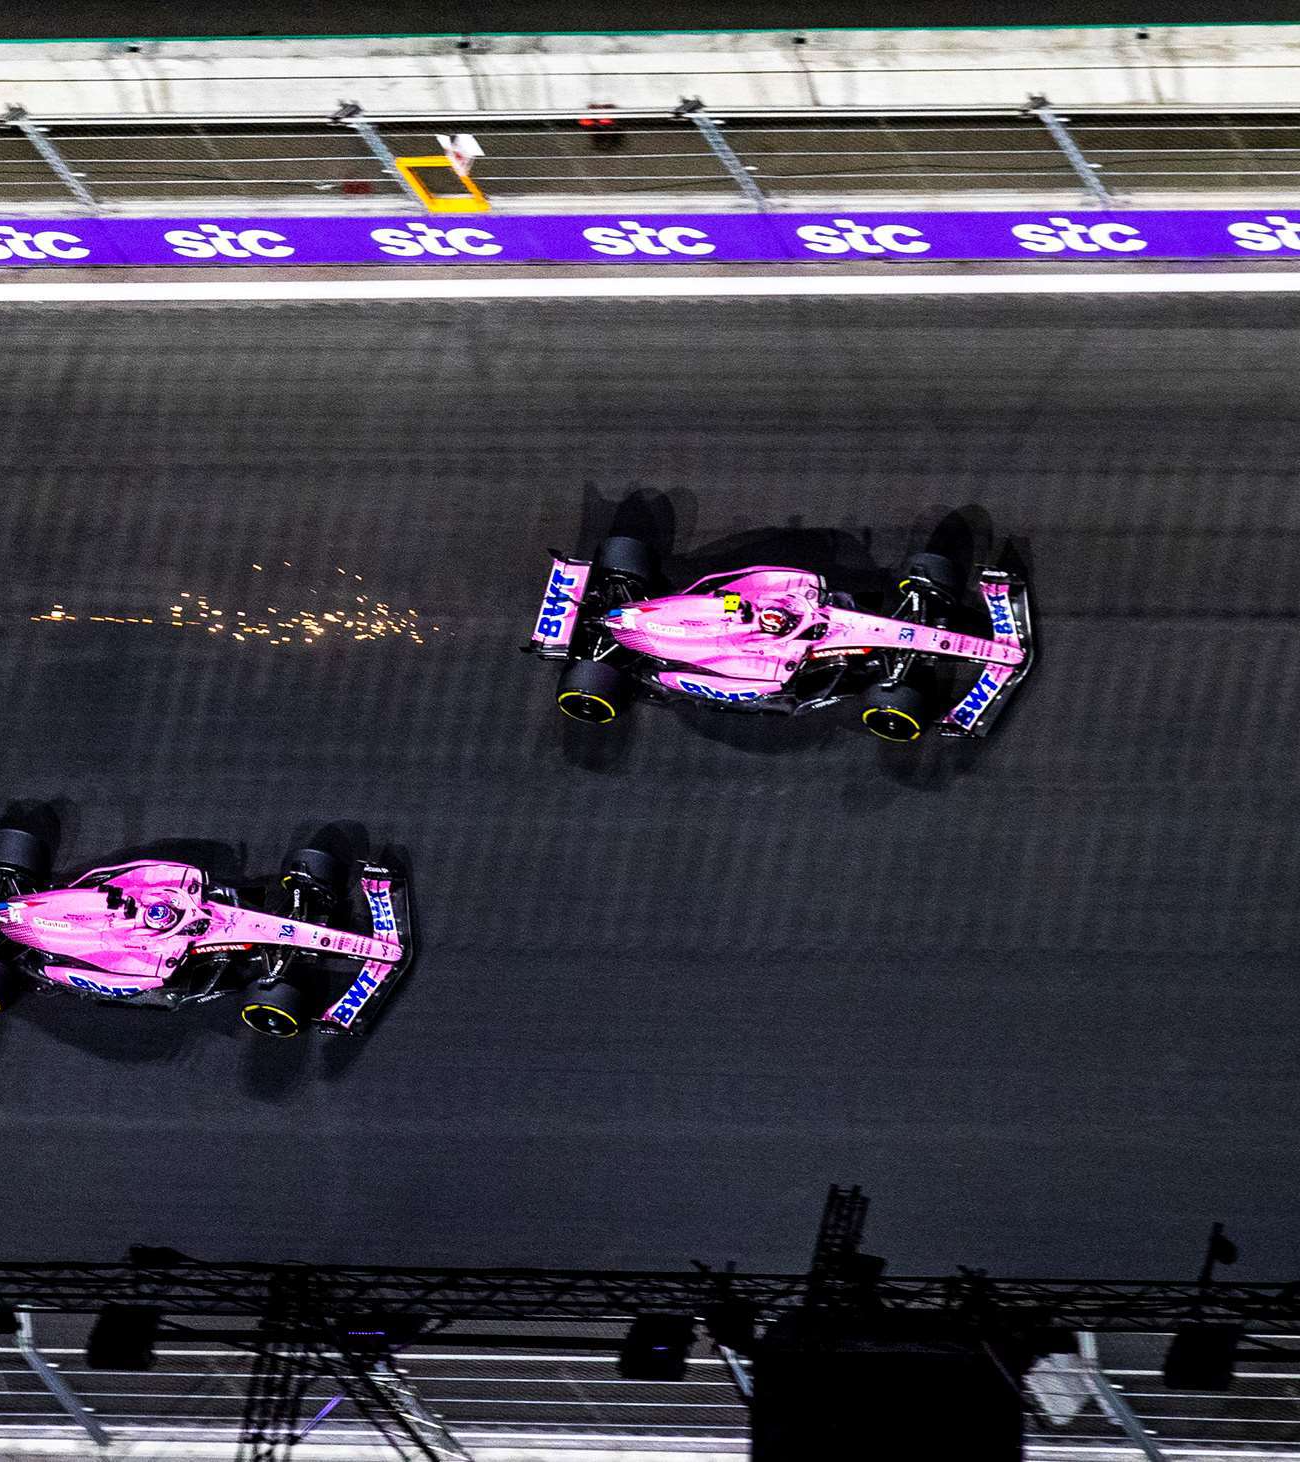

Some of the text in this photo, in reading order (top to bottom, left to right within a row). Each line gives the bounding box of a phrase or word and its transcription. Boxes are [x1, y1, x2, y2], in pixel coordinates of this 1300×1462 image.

[164, 224, 294, 258] stc
[371, 223, 502, 256] stc
[583, 221, 715, 255] stc
[797, 220, 930, 253] stc
[1012, 218, 1147, 252] stc
[1228, 216, 1300, 251] st
[538, 569, 575, 637] BWT
[987, 594, 1014, 634] BWT
[953, 673, 998, 727] BWT
[368, 890, 394, 931] BWT
[278, 924, 295, 938] 14
[332, 970, 378, 1025] BWT
